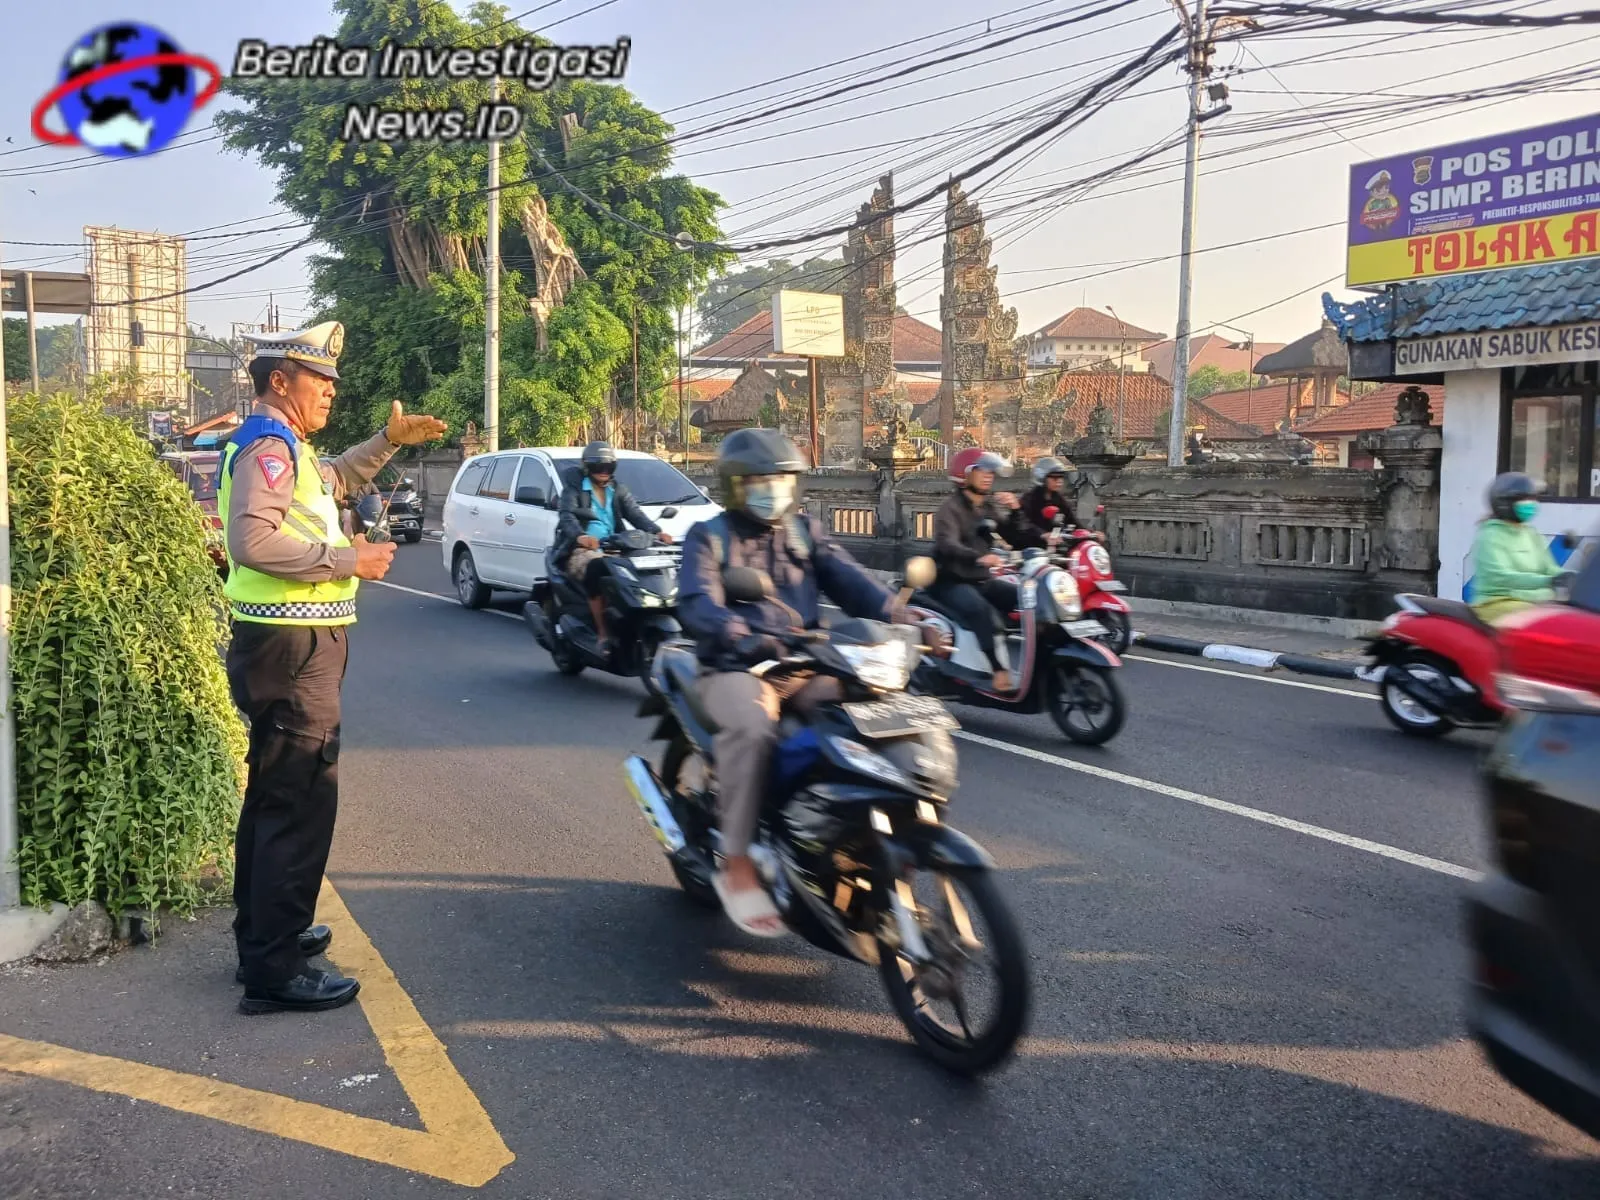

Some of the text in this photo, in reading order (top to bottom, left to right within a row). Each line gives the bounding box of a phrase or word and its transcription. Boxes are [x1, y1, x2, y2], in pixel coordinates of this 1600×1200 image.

[1410, 180, 1494, 214] SIMP.
[1502, 159, 1600, 199] BERIN
[1441, 147, 1511, 181] POS
[1408, 219, 1556, 275] TOLAK
[1397, 325, 1600, 365] GUNAKAN SABUK KES
